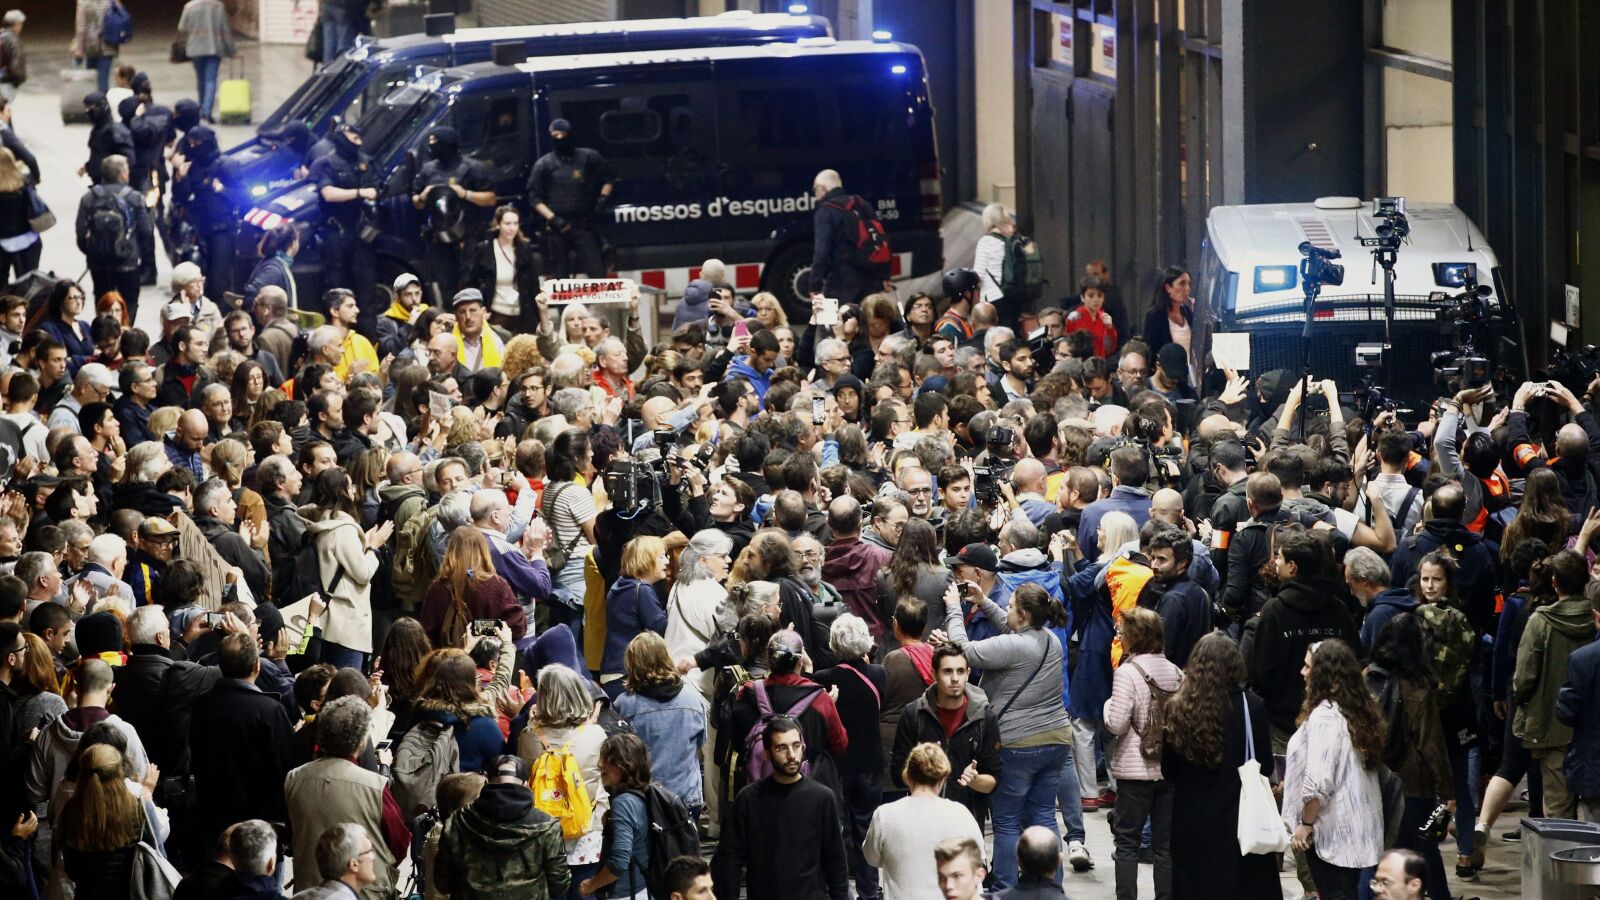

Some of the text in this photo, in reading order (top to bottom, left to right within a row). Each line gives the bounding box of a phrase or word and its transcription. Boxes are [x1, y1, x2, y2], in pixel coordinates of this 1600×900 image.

[614, 192, 816, 223] mossos d'esquadr
[552, 281, 625, 293] LLIBERTAT
